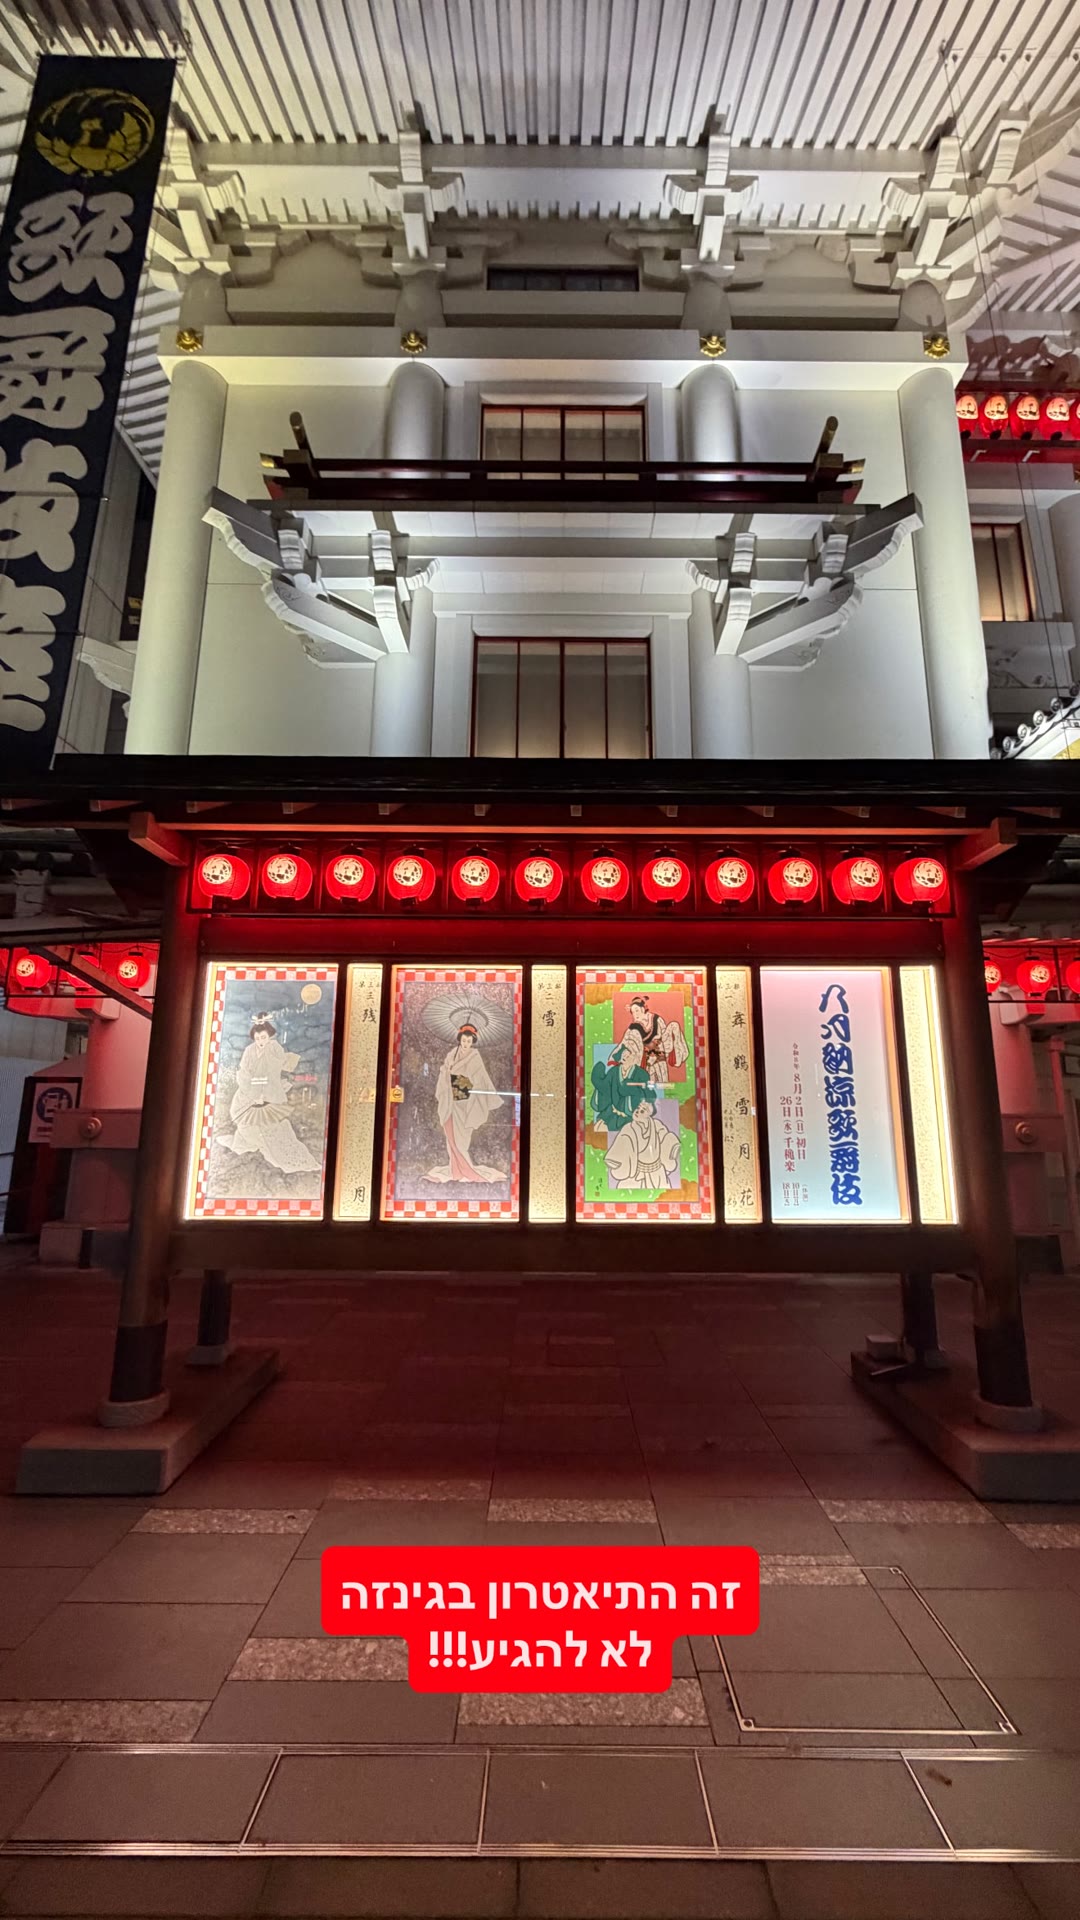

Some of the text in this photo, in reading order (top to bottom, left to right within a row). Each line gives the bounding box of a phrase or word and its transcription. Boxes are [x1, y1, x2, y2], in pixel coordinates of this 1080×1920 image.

[818, 984, 863, 1205] 八月納涼歌舞伎
